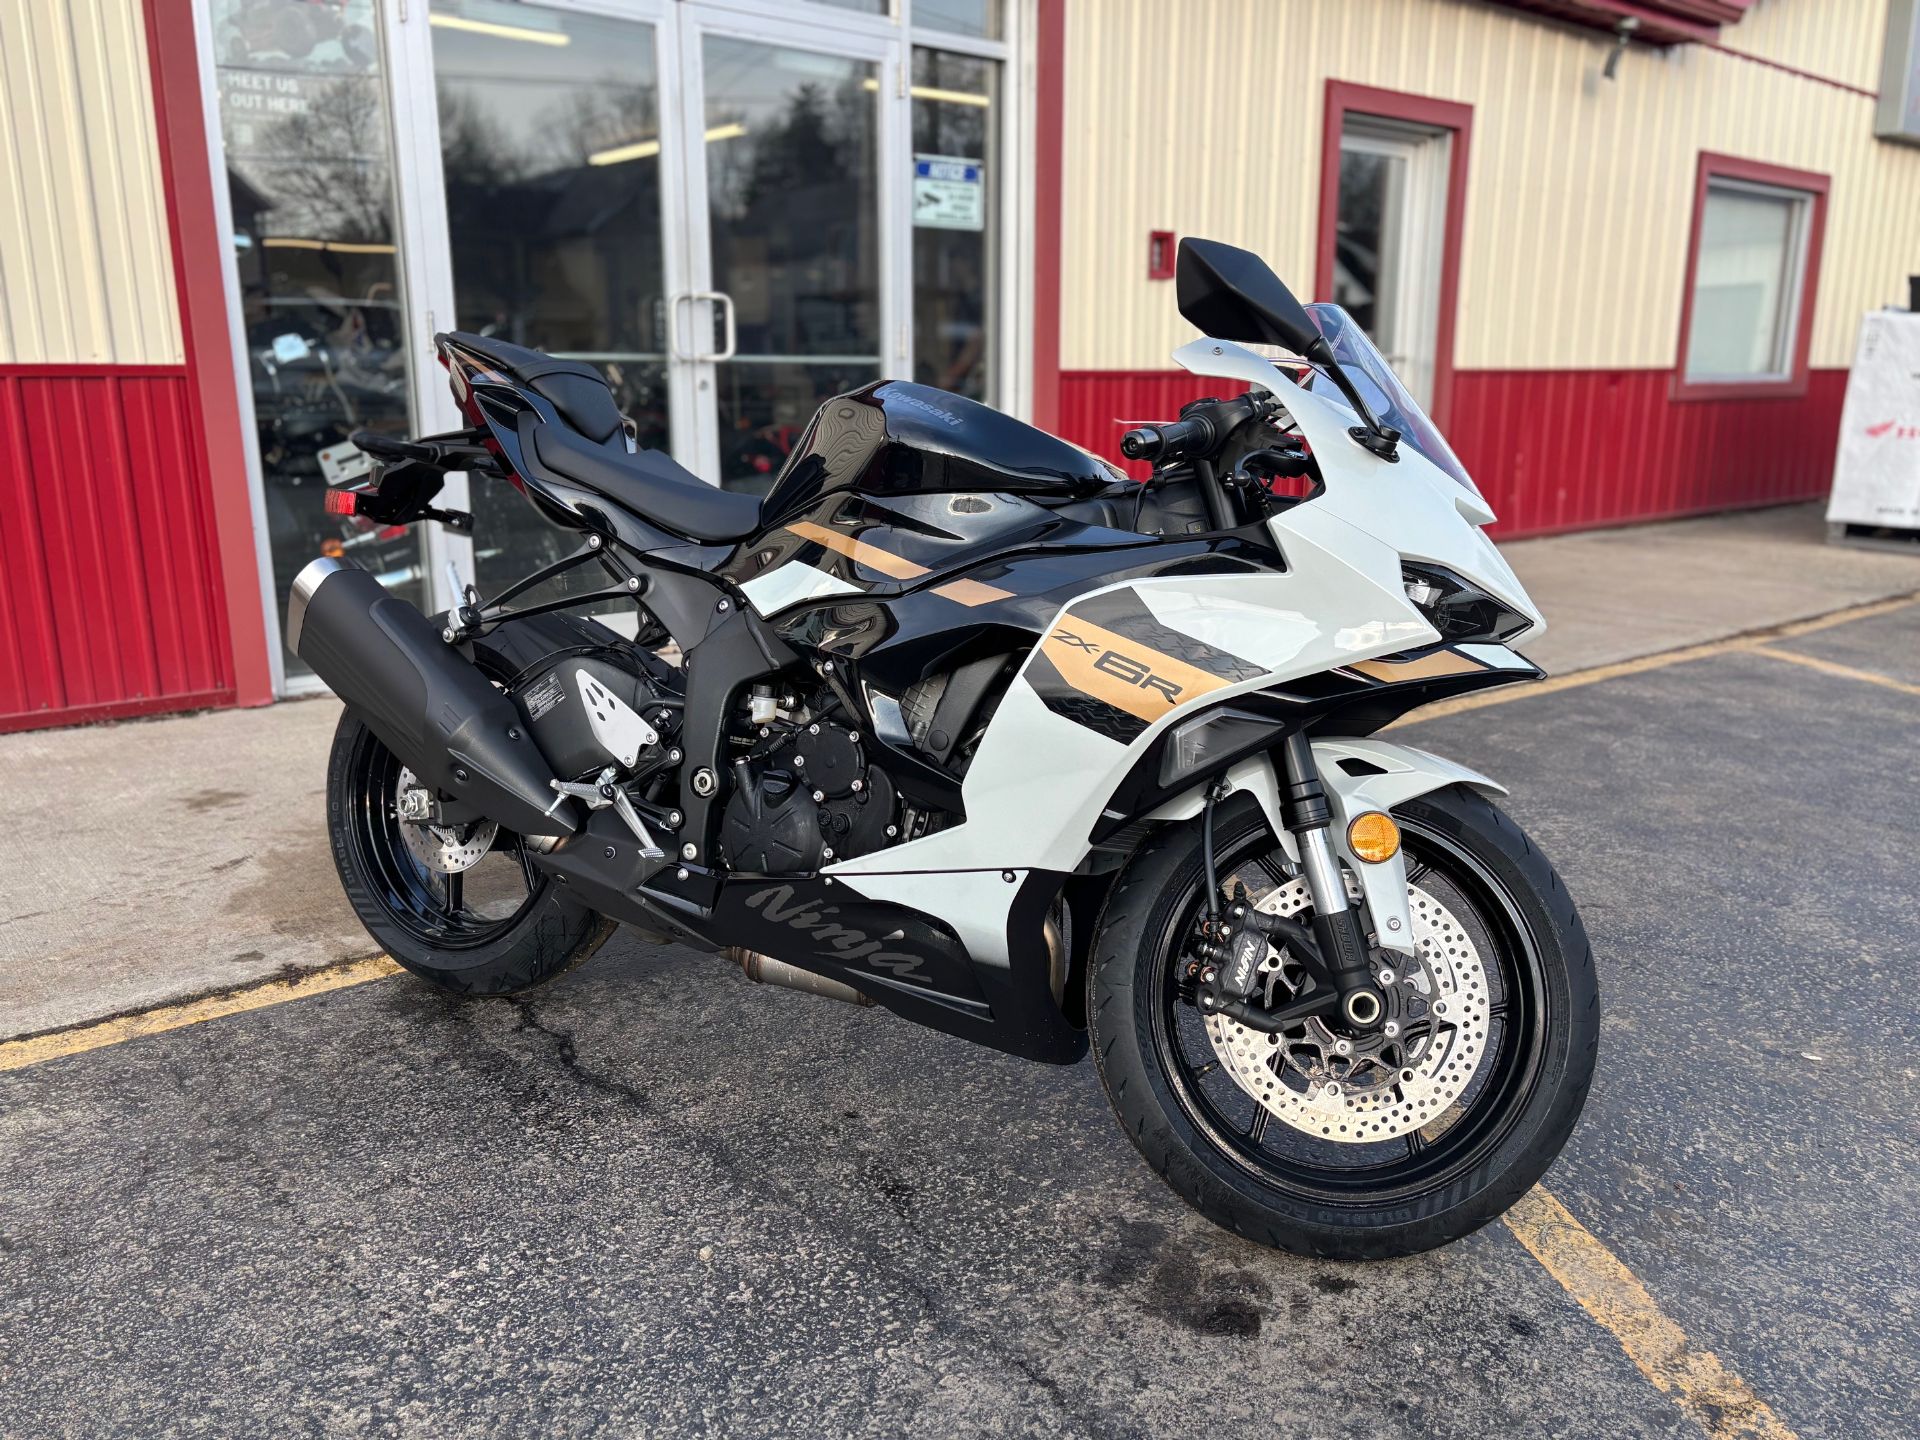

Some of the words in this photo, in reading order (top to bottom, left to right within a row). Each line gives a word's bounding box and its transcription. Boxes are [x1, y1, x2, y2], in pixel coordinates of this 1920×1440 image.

[228, 73, 271, 90] MEET
[275, 79, 299, 93] US
[230, 93, 262, 109] OUT
[877, 387, 964, 427] Kawasaki
[1051, 628, 1183, 706] ZX-6R
[333, 827, 356, 885] DIABLO
[744, 884, 933, 983] Ninja
[1335, 917, 1357, 962] SHOWA
[1234, 940, 1256, 987] NISSIN
[1318, 1207, 1411, 1225] DIABLO
